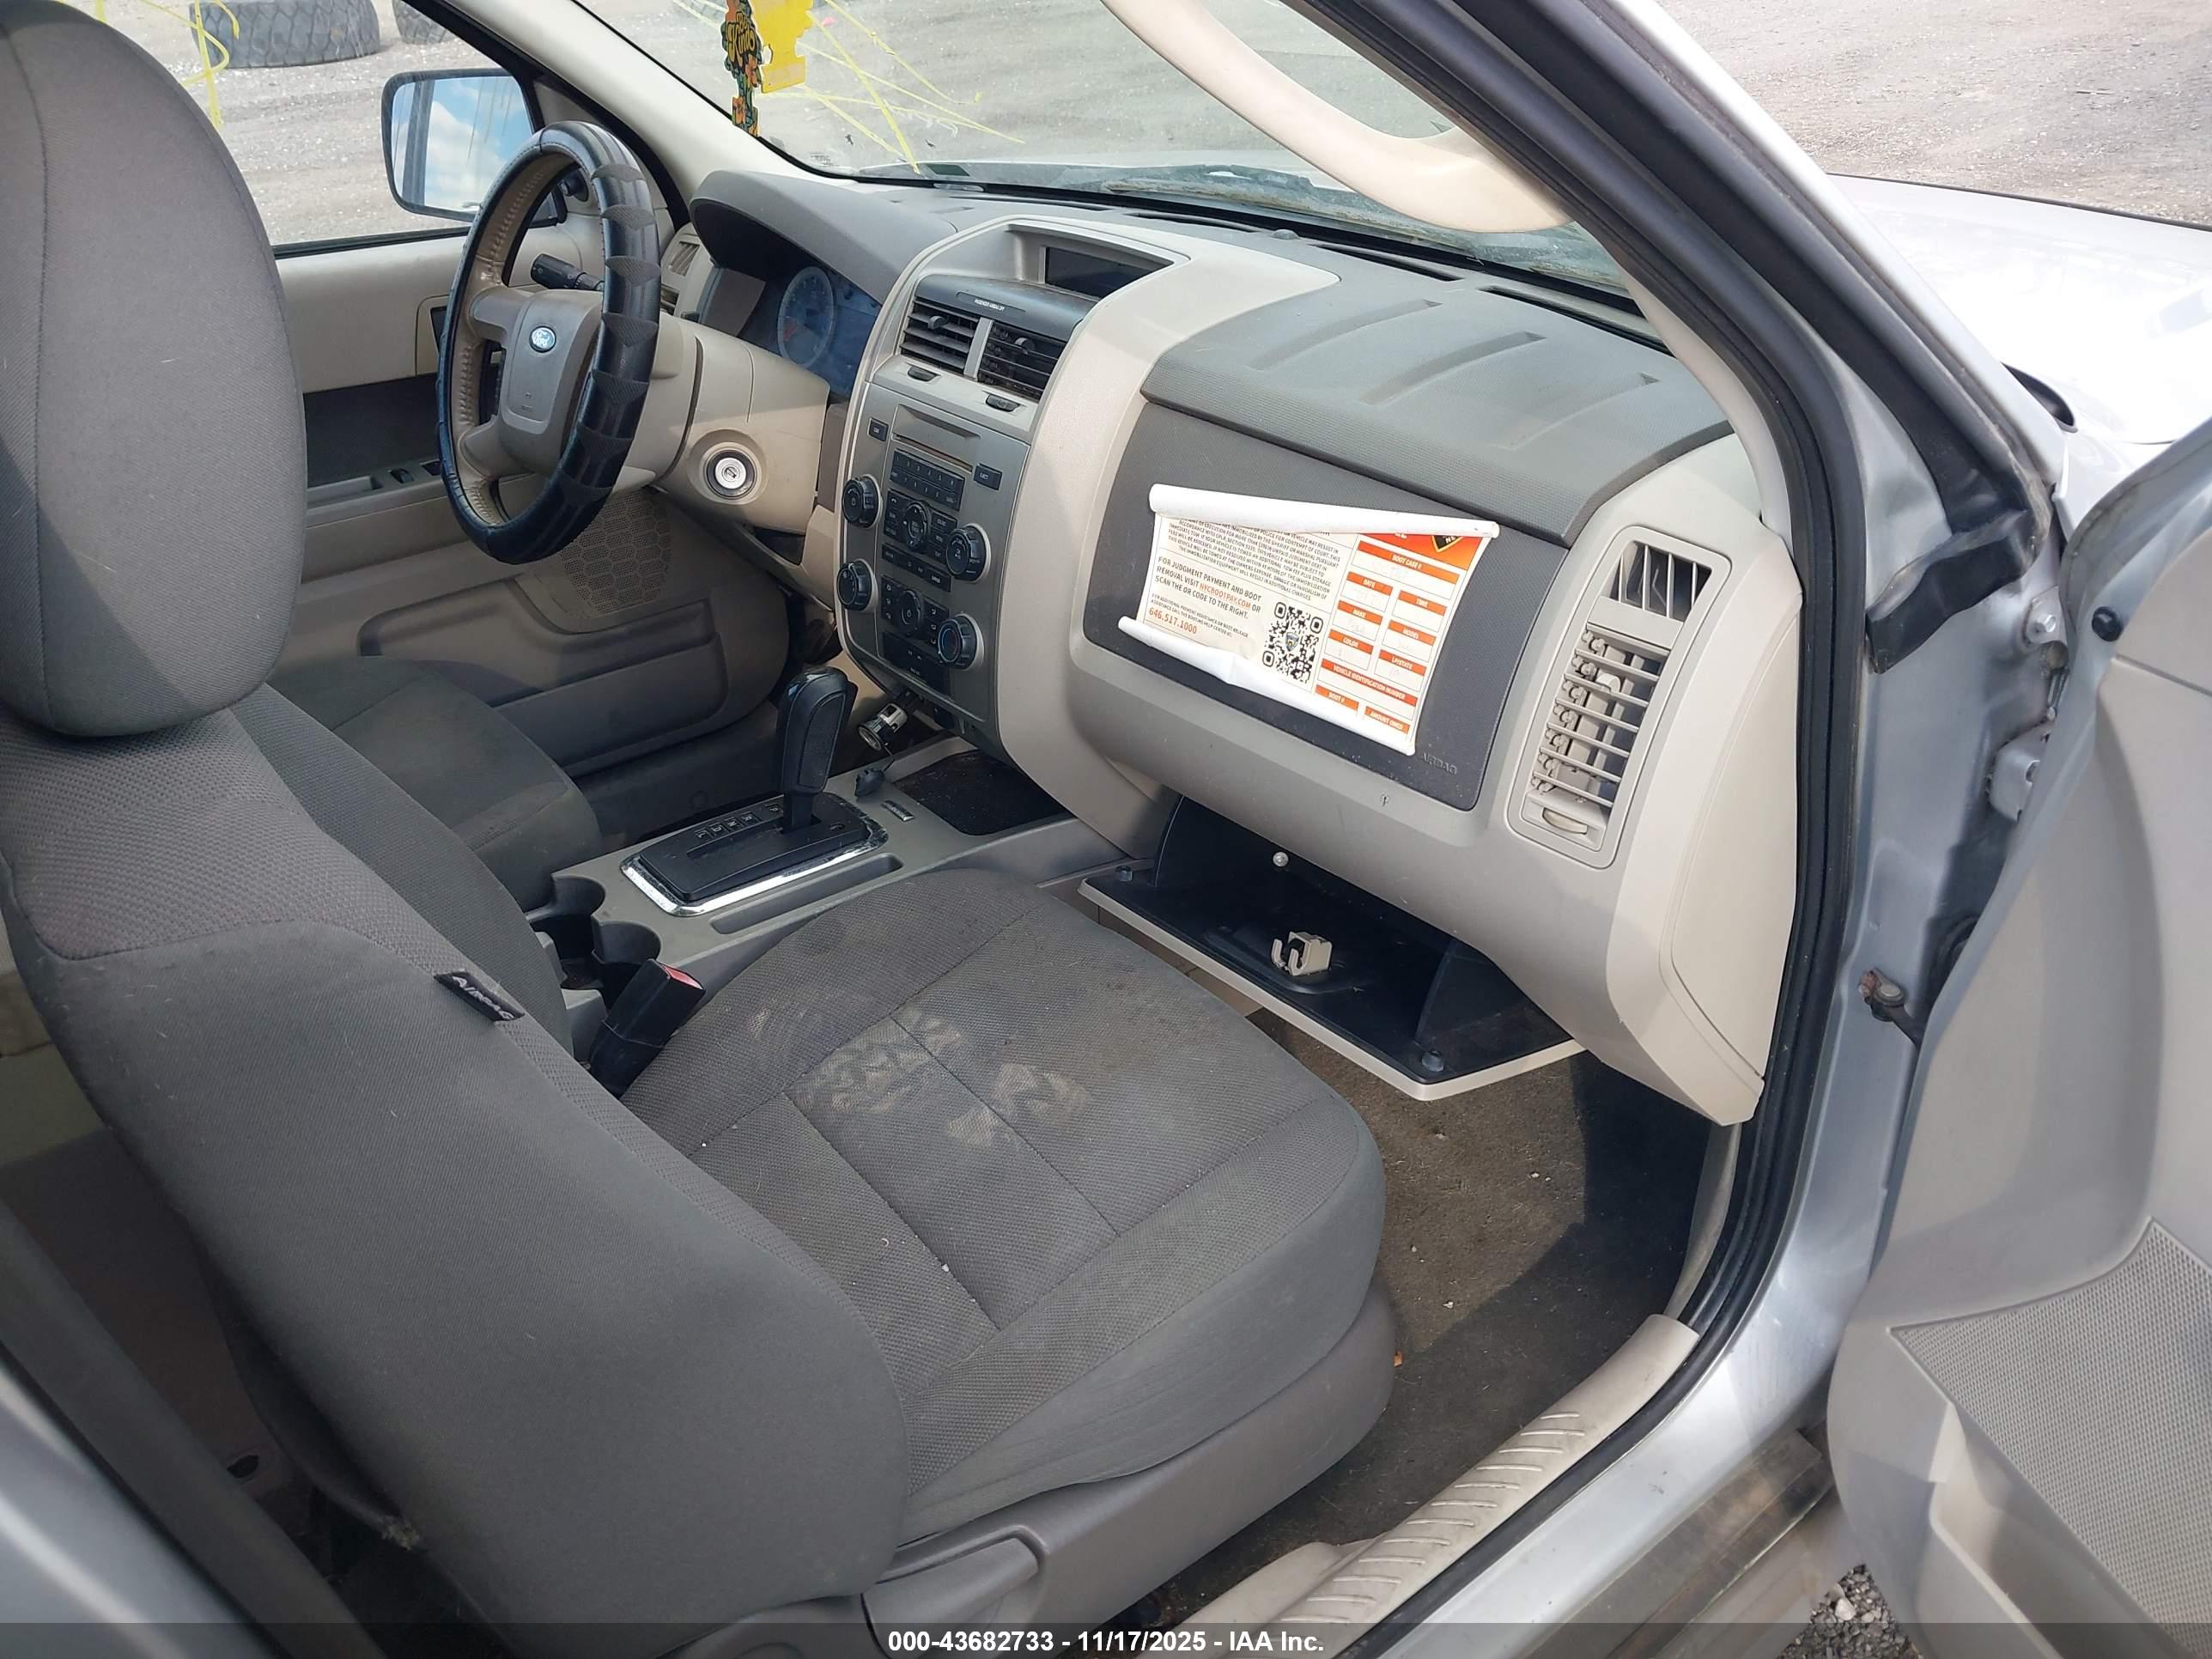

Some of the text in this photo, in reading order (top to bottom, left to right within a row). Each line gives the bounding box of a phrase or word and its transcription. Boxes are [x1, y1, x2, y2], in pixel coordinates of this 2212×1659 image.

[1169, 523, 1190, 535] IMMEDIATE
[1216, 539, 1232, 549] VEHICLE
[1238, 548, 1251, 556] TOWED
[1259, 555, 1282, 569] ADDITIONAL
[1301, 570, 1311, 579] PLUS
[1312, 576, 1331, 586] STORAGE
[1204, 522, 1226, 534] EXECUTION
[1272, 546, 1289, 557] UNPAID
[1289, 553, 1311, 565] JUDGMENT
[1311, 560, 1322, 569] DEBT
[1205, 529, 1215, 537] WITH
[1227, 536, 1245, 548] SECTION
[1266, 550, 1283, 562] VEHICLE
[1299, 564, 1318, 574] SUBJECT
[1276, 534, 1284, 543] FOR
[1285, 537, 1307, 550] CONTEMPT
[1318, 543, 1333, 553] RESULT
[1186, 549, 1216, 564] IMMOBILIZATION
[1217, 560, 1240, 572] EQUIPMENT
[1240, 568, 1249, 577] WILL
[1250, 572, 1264, 582] RESULT
[1268, 580, 1291, 593] ADDITIONAL
[1296, 549, 1316, 560] MARSHAL
[1316, 556, 1338, 568] PURSUANT
[1392, 554, 1405, 565] BOOT
[1405, 559, 1417, 569] CASE
[1157, 566, 1261, 613] REMOVAL VISIT NYCBOOTPAY.COM OR
[1158, 556, 1262, 602] FOR JUDGMENT PAYMENT AND BOOT
[1236, 560, 1253, 571] OWNERS
[1297, 584, 1321, 597] VANDALISM
[1267, 566, 1280, 575] HOURS
[1296, 577, 1330, 593] IMMOBILIZATION
[1363, 578, 1376, 588] DATE
[1155, 576, 1170, 586] SCAN
[1172, 581, 1182, 591] THE
[1192, 590, 1208, 601] CODE
[1209, 597, 1216, 605] TO
[1217, 601, 1228, 611] THE
[1229, 605, 1249, 619] RIGHT.
[1415, 598, 1429, 608] TIME
[1149, 607, 1197, 634] 646.517.1000
[1352, 608, 1366, 619] MAKE
[1343, 637, 1359, 648] COLOR
[1403, 629, 1420, 639] MODEL
[1332, 664, 1406, 700] VEHICLE IDENTIFICATION NUMBER
[1328, 692, 1341, 702] BOOT
[1370, 710, 1389, 725] AMOUNT
[452, 975, 515, 1020] AIRBAG
